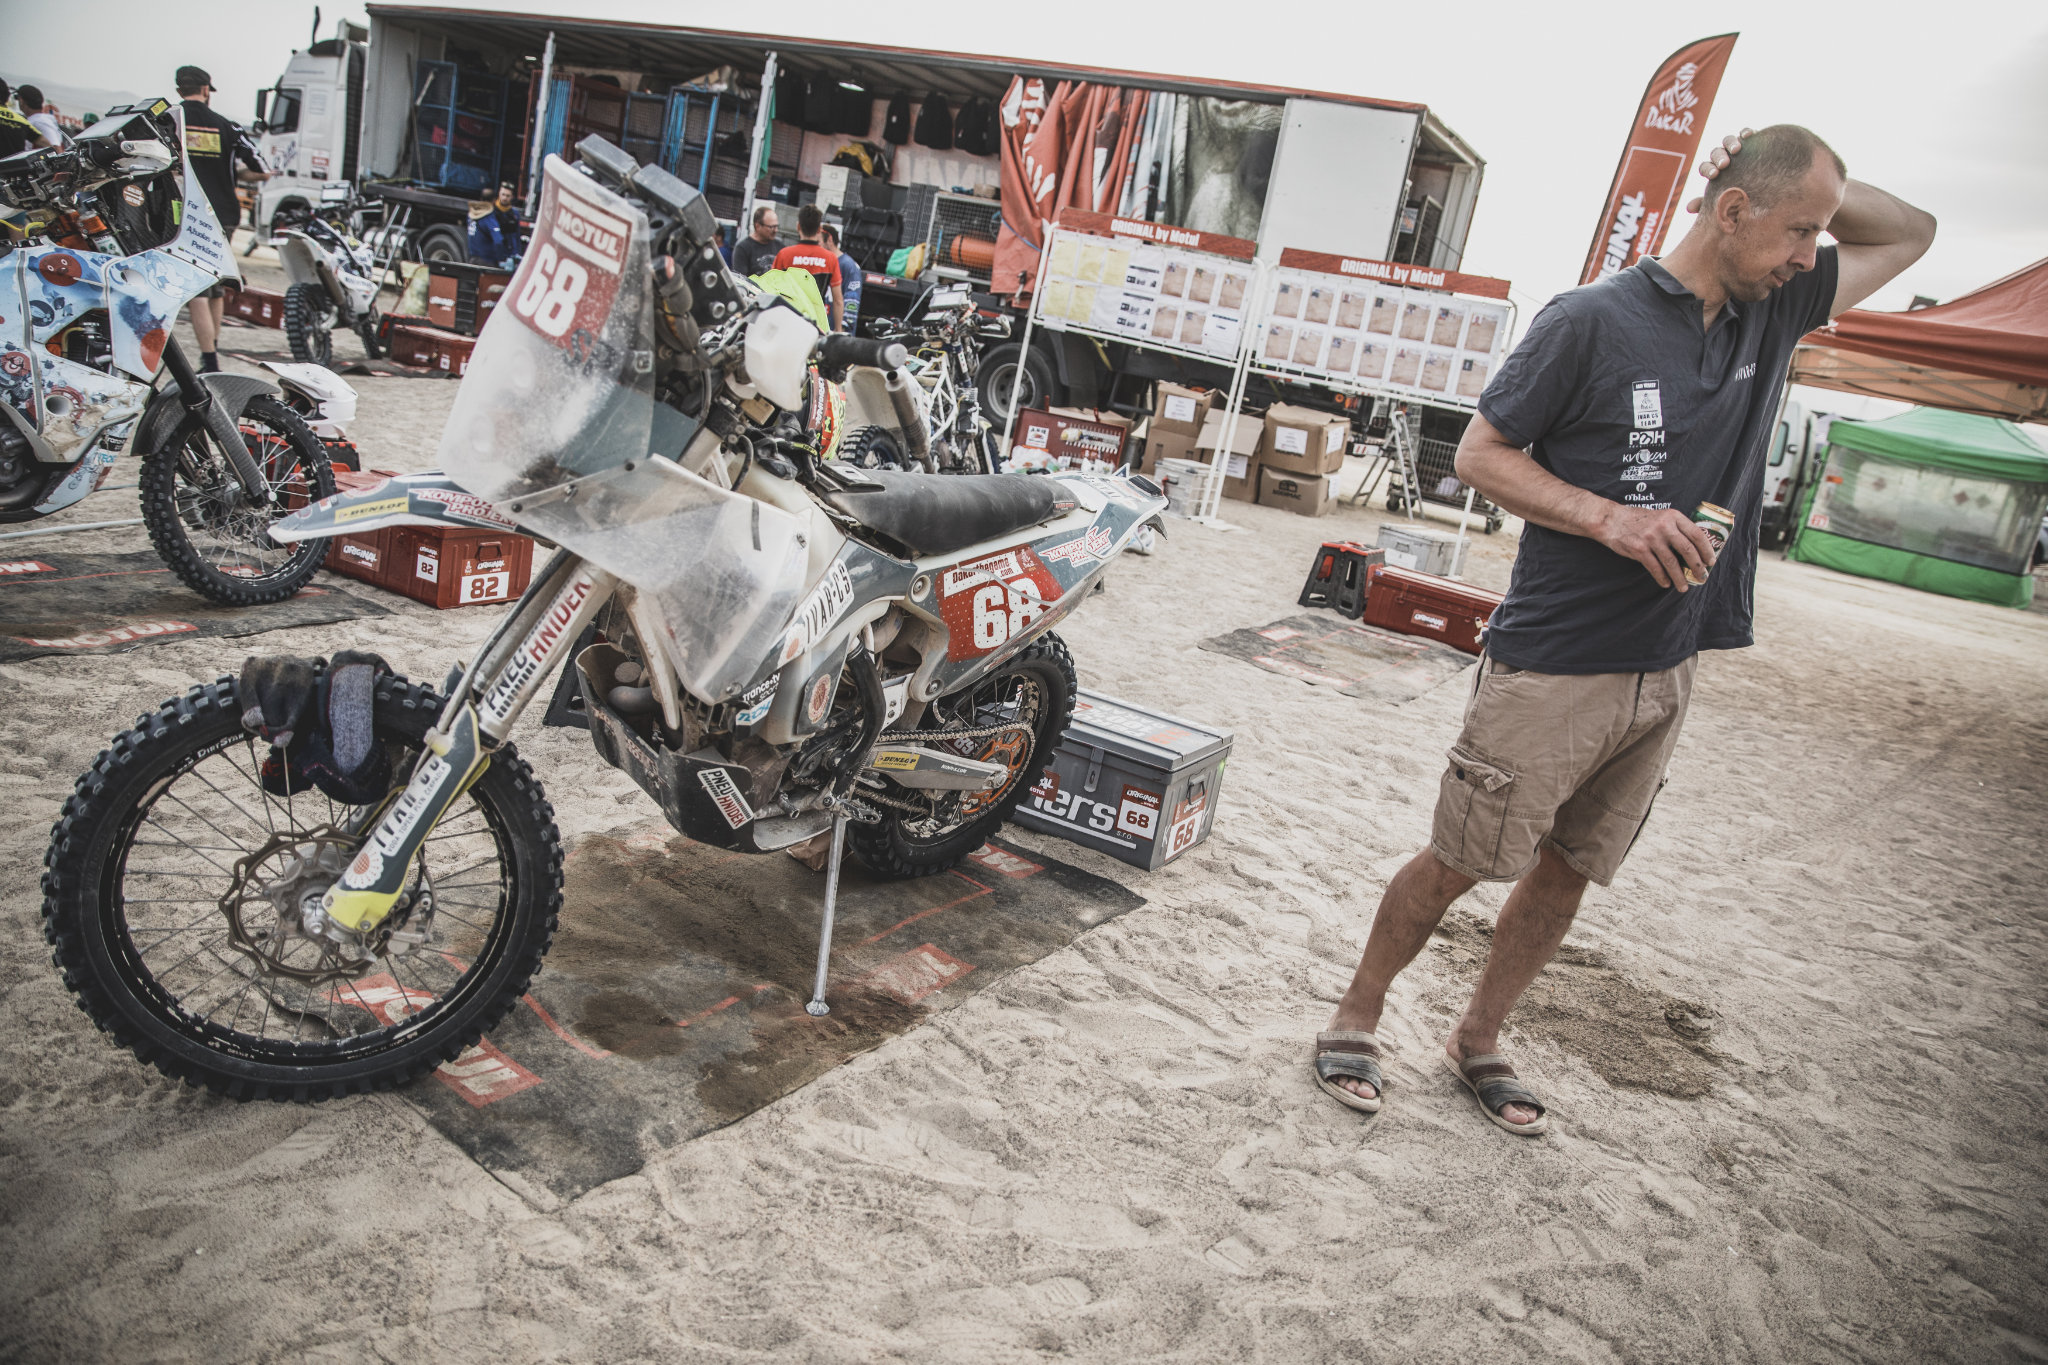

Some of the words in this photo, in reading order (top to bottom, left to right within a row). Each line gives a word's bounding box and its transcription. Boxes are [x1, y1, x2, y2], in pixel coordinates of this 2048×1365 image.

[1645, 105, 1694, 135] DAKAR
[186, 214, 197, 224] my
[187, 200, 198, 210] For
[557, 207, 619, 257] MOTUL
[1111, 219, 1153, 239] ORIGINAL
[1156, 227, 1169, 243] by
[1169, 229, 1200, 247] Motul
[1595, 191, 1646, 282] GINAL
[1637, 211, 1660, 255] MOTUL
[793, 256, 826, 267] MOTUL
[1340, 259, 1391, 279] ORIGINAL
[1393, 269, 1409, 283] by
[1410, 269, 1445, 287] Motul
[516, 242, 589, 337] 68
[350, 501, 406, 517] DUNLOP
[421, 562, 434, 575] 82
[470, 577, 498, 599] 82
[974, 577, 1044, 649] 68
[883, 756, 917, 765] DUNLOP
[707, 770, 732, 796] PNEU
[717, 795, 747, 828] HNIDEK
[1126, 812, 1150, 829] 68
[1174, 824, 1195, 852] 68
